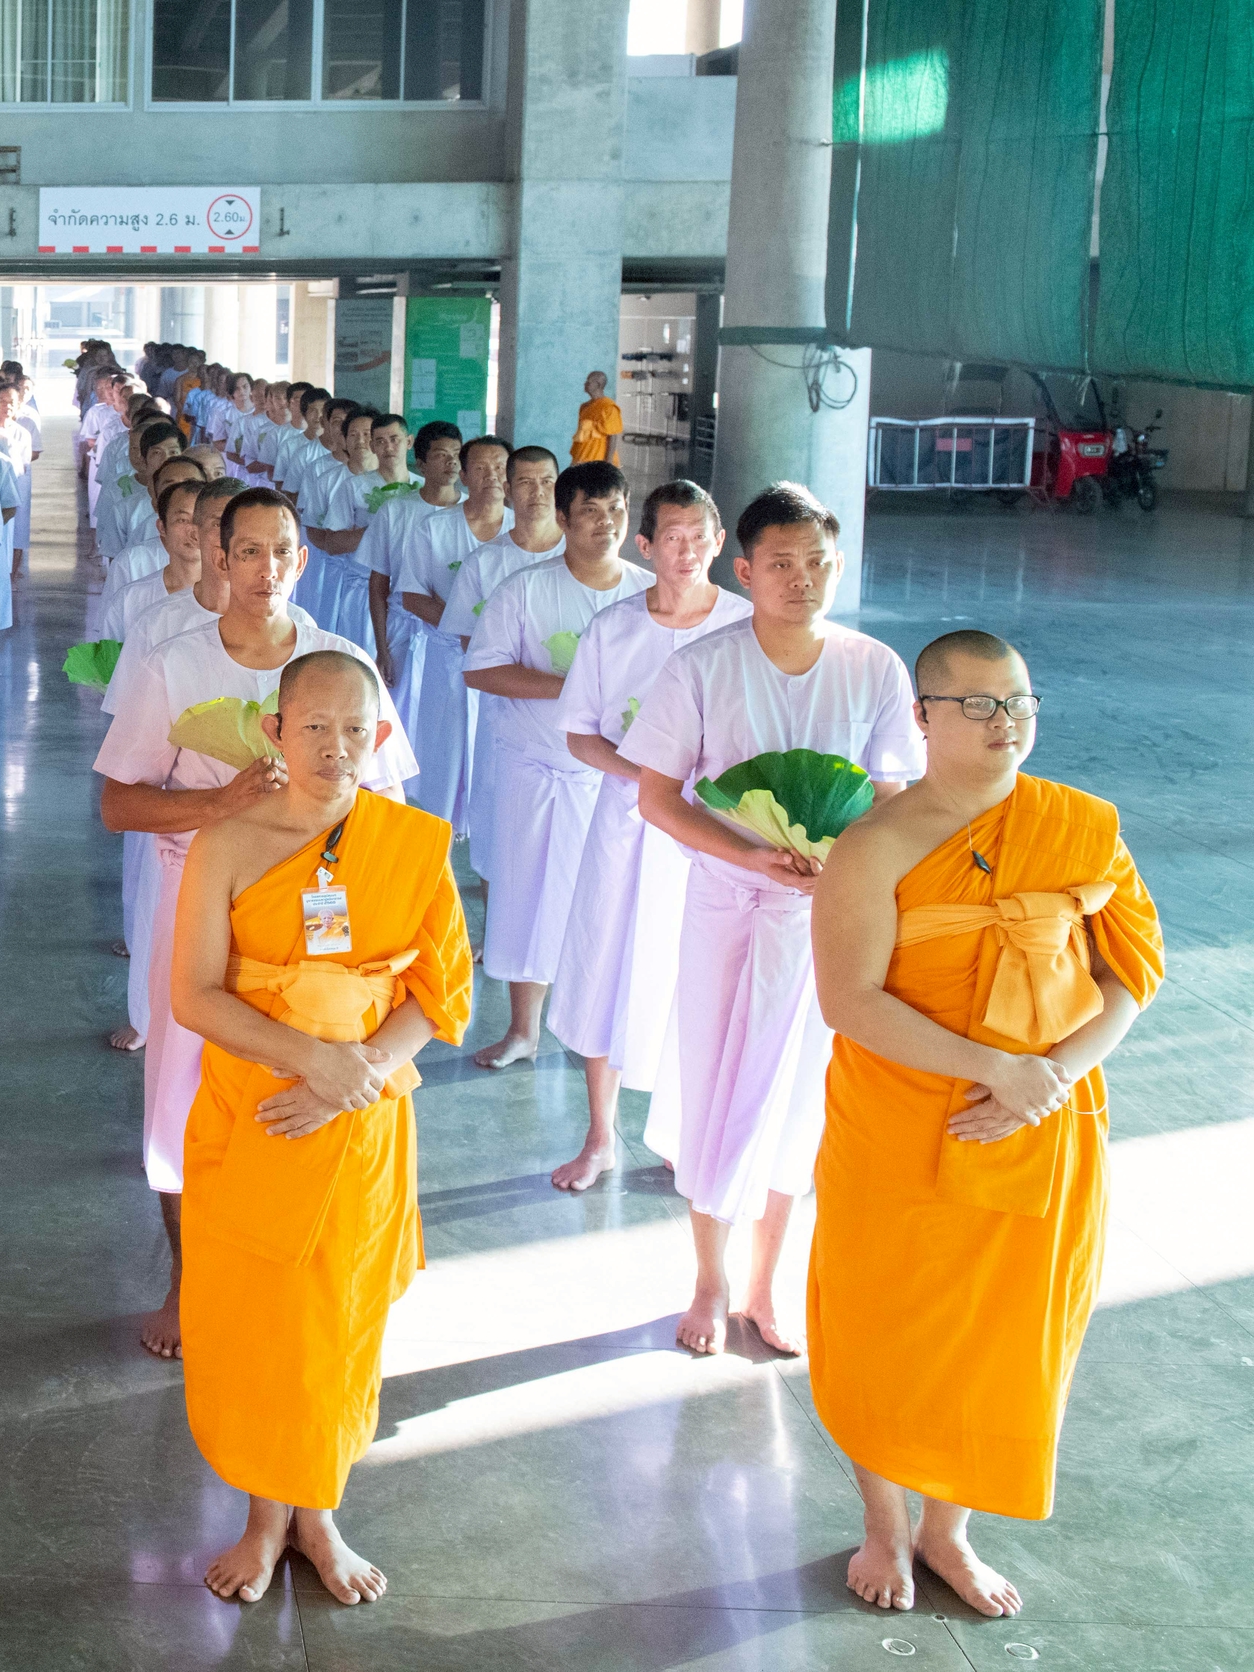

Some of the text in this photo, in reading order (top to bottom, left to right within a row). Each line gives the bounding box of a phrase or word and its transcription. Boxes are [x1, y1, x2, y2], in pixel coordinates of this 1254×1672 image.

[47, 208, 201, 232] จำกัดความสูง 2.6 ม.
